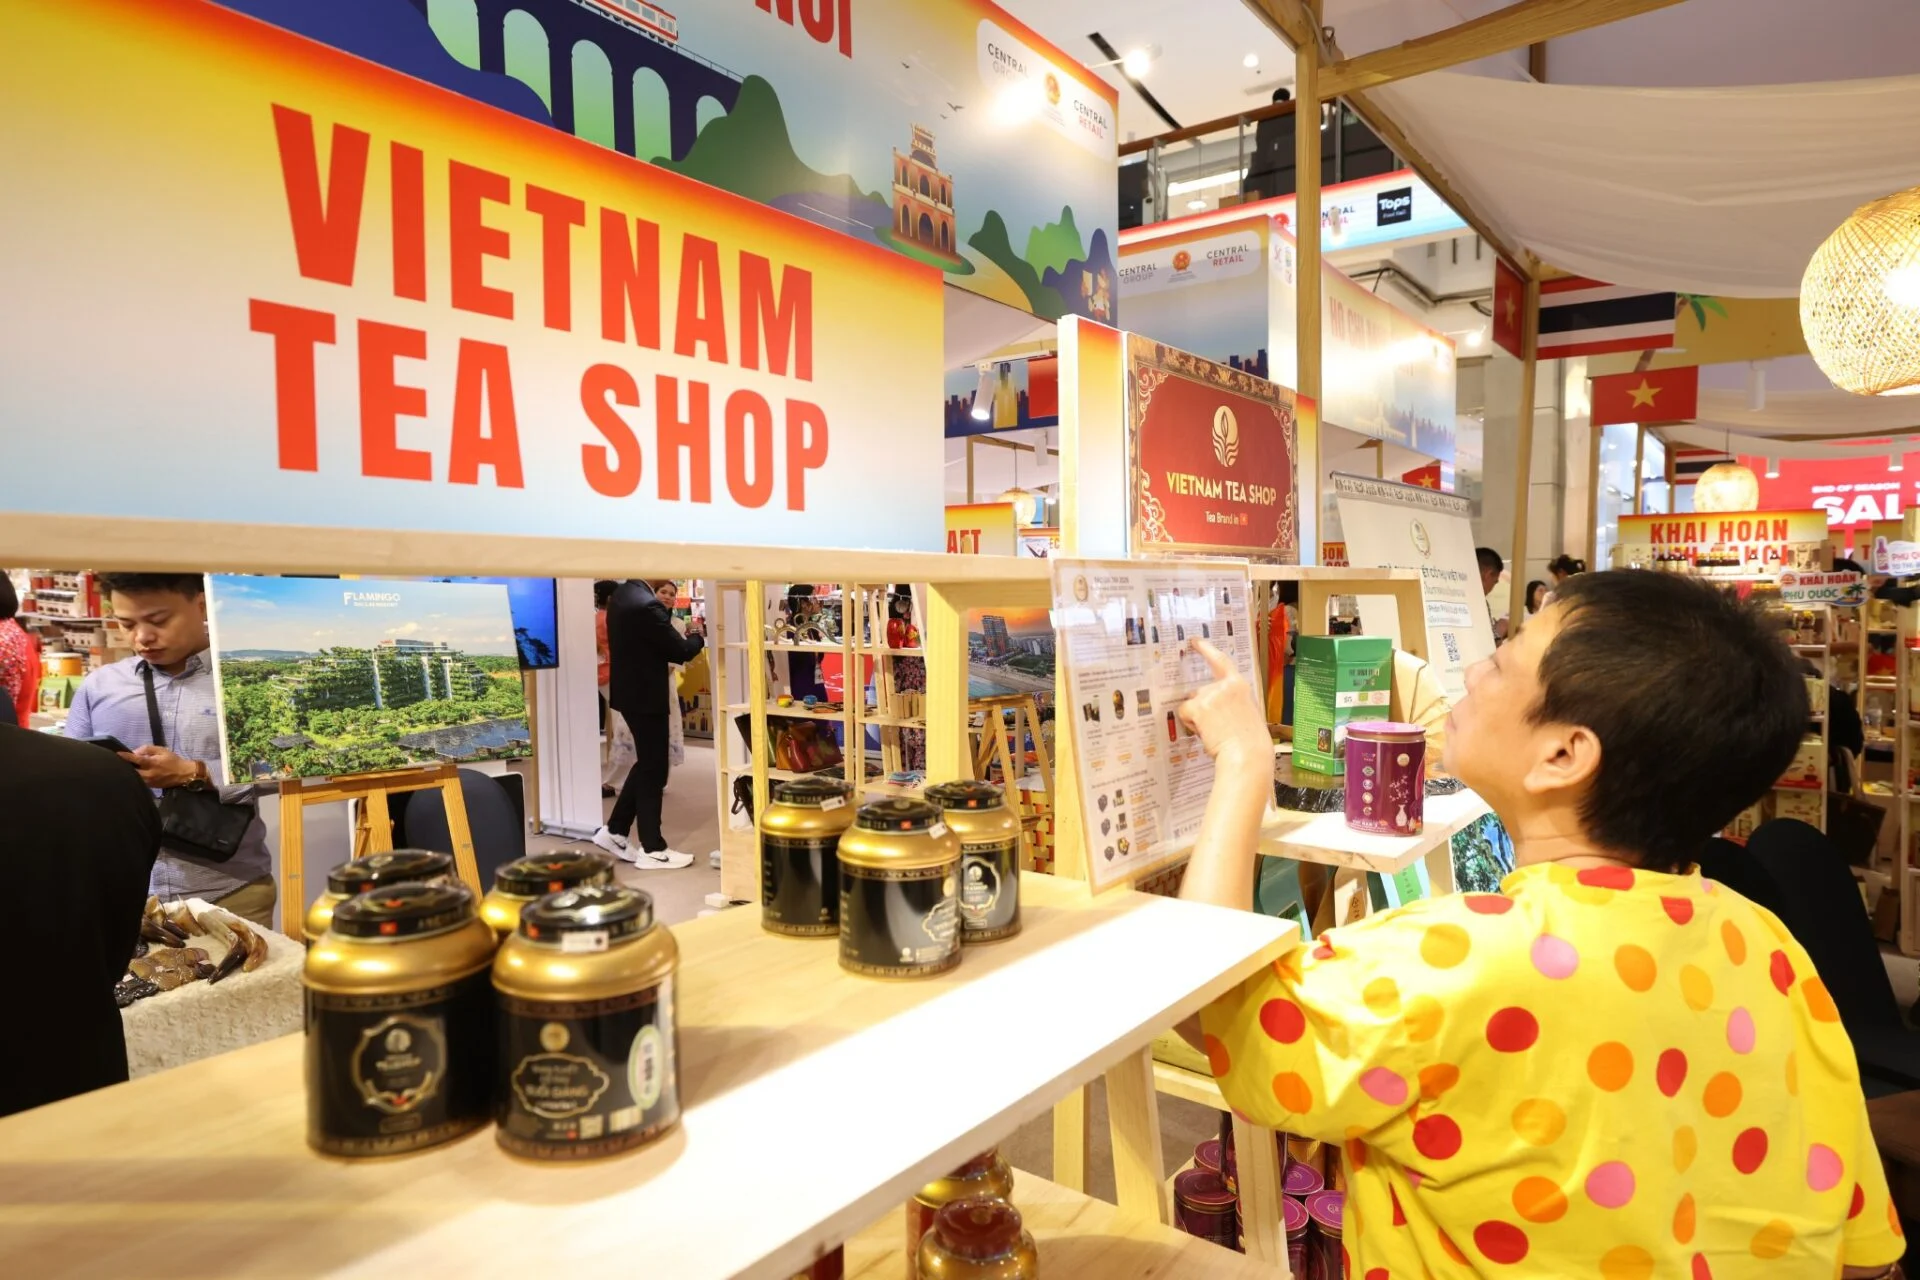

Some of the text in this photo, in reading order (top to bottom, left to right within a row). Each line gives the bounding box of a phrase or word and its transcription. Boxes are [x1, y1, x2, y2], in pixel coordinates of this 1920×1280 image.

[987, 42, 1029, 79] CENTRAL
[1073, 99, 1108, 129] CENTRAL
[1379, 196, 1410, 211] Tops
[271, 102, 813, 382] VIETNAM
[1206, 244, 1249, 259] CENTRAL
[1213, 255, 1244, 267] RETAIL
[1119, 263, 1157, 277] CENTRAL
[1123, 272, 1153, 284] GROUP
[248, 298, 829, 512] TEA SHOP
[1166, 471, 1277, 506] VIETNAM TEA SHOP
[1205, 511, 1239, 525] Tea Brand in
[1651, 519, 1789, 544] KHAI HOAN
[343, 591, 401, 606] FLAMINGO
